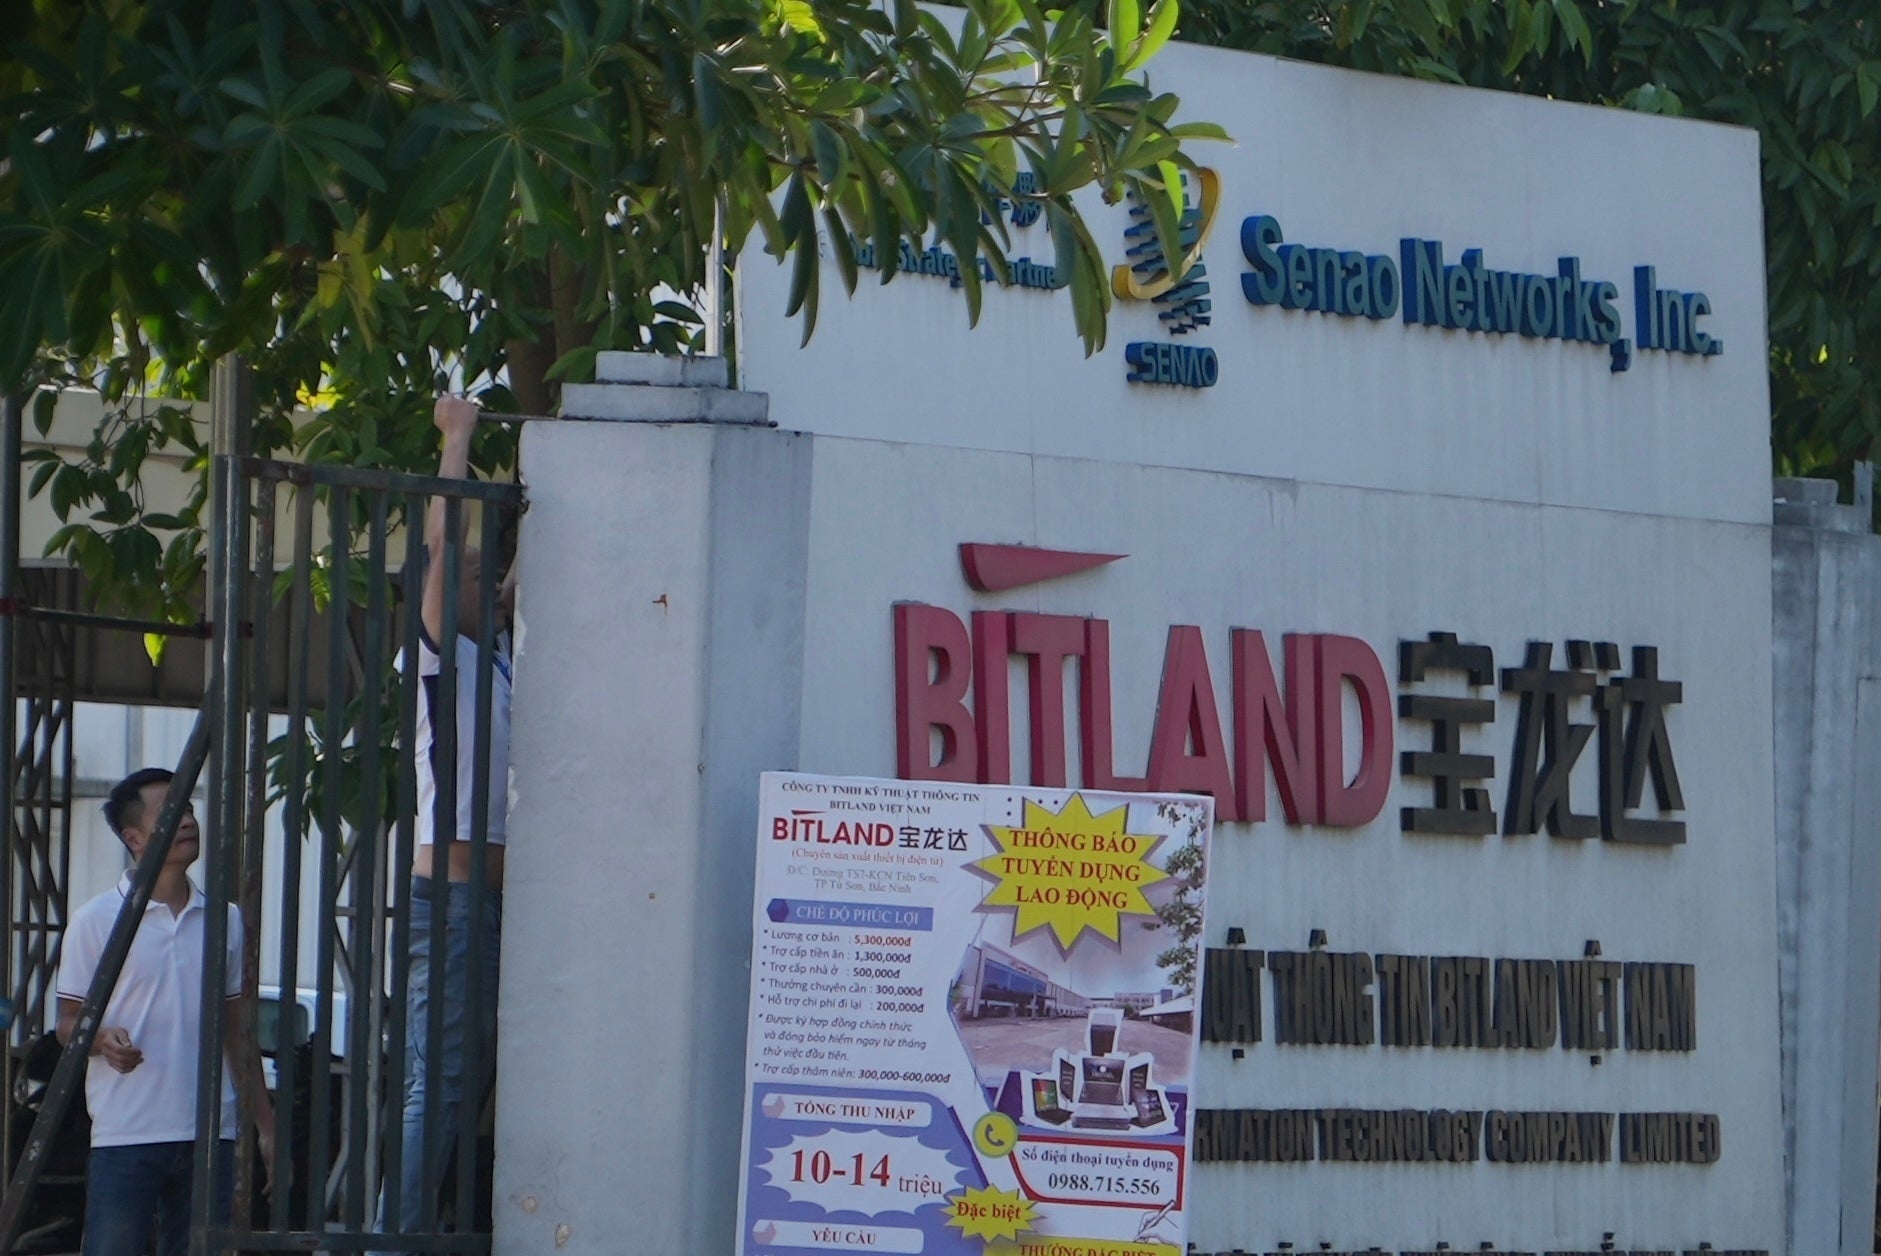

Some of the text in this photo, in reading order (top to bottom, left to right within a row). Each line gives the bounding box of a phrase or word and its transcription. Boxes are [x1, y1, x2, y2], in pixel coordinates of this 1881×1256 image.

[1241, 215, 1723, 373] Senao Networks, Inc.
[1126, 342, 1219, 388] SENAO
[893, 542, 1687, 844] BITLAND 宝龙达
[781, 780, 812, 793] CÔNG
[961, 792, 980, 802] TIN
[829, 800, 930, 814] BITLAND VIỆT NAM
[771, 808, 968, 851] BITLAND 宝龙达
[1009, 824, 1137, 854] THÔNG BÁO
[1079, 861, 1140, 885] DỤNG
[1015, 885, 1128, 913] LAO ĐỘNG
[795, 902, 918, 926] CHẾ ĐỘ PHÚC LỢI
[853, 934, 911, 948] 5,300,000đ
[854, 951, 911, 965] 1,300,000đ
[852, 967, 900, 980] 500,000đ
[875, 984, 923, 997] 300,000đ
[1268, 929, 1697, 1066] THÔNG TIN BITLAND VIỆT NAM
[876, 1001, 924, 1014] 200,000đ
[858, 1069, 950, 1085] 300,000-600,000đ
[839, 1104, 870, 1117] THU
[874, 1105, 915, 1123] NHẬP
[1316, 1109, 1721, 1164] TECHNOLOGY COMPANY LIMITED
[1021, 1143, 1037, 1160] Số
[1040, 1149, 1067, 1165] điện
[1070, 1151, 1102, 1168] thoại
[1142, 1155, 1174, 1172] dụng
[789, 1148, 944, 1198] 10-14 triệu
[1047, 1172, 1160, 1195] 0988.715.556
[956, 1201, 1022, 1223] Đặc biệt
[812, 1226, 842, 1243] YÊU
